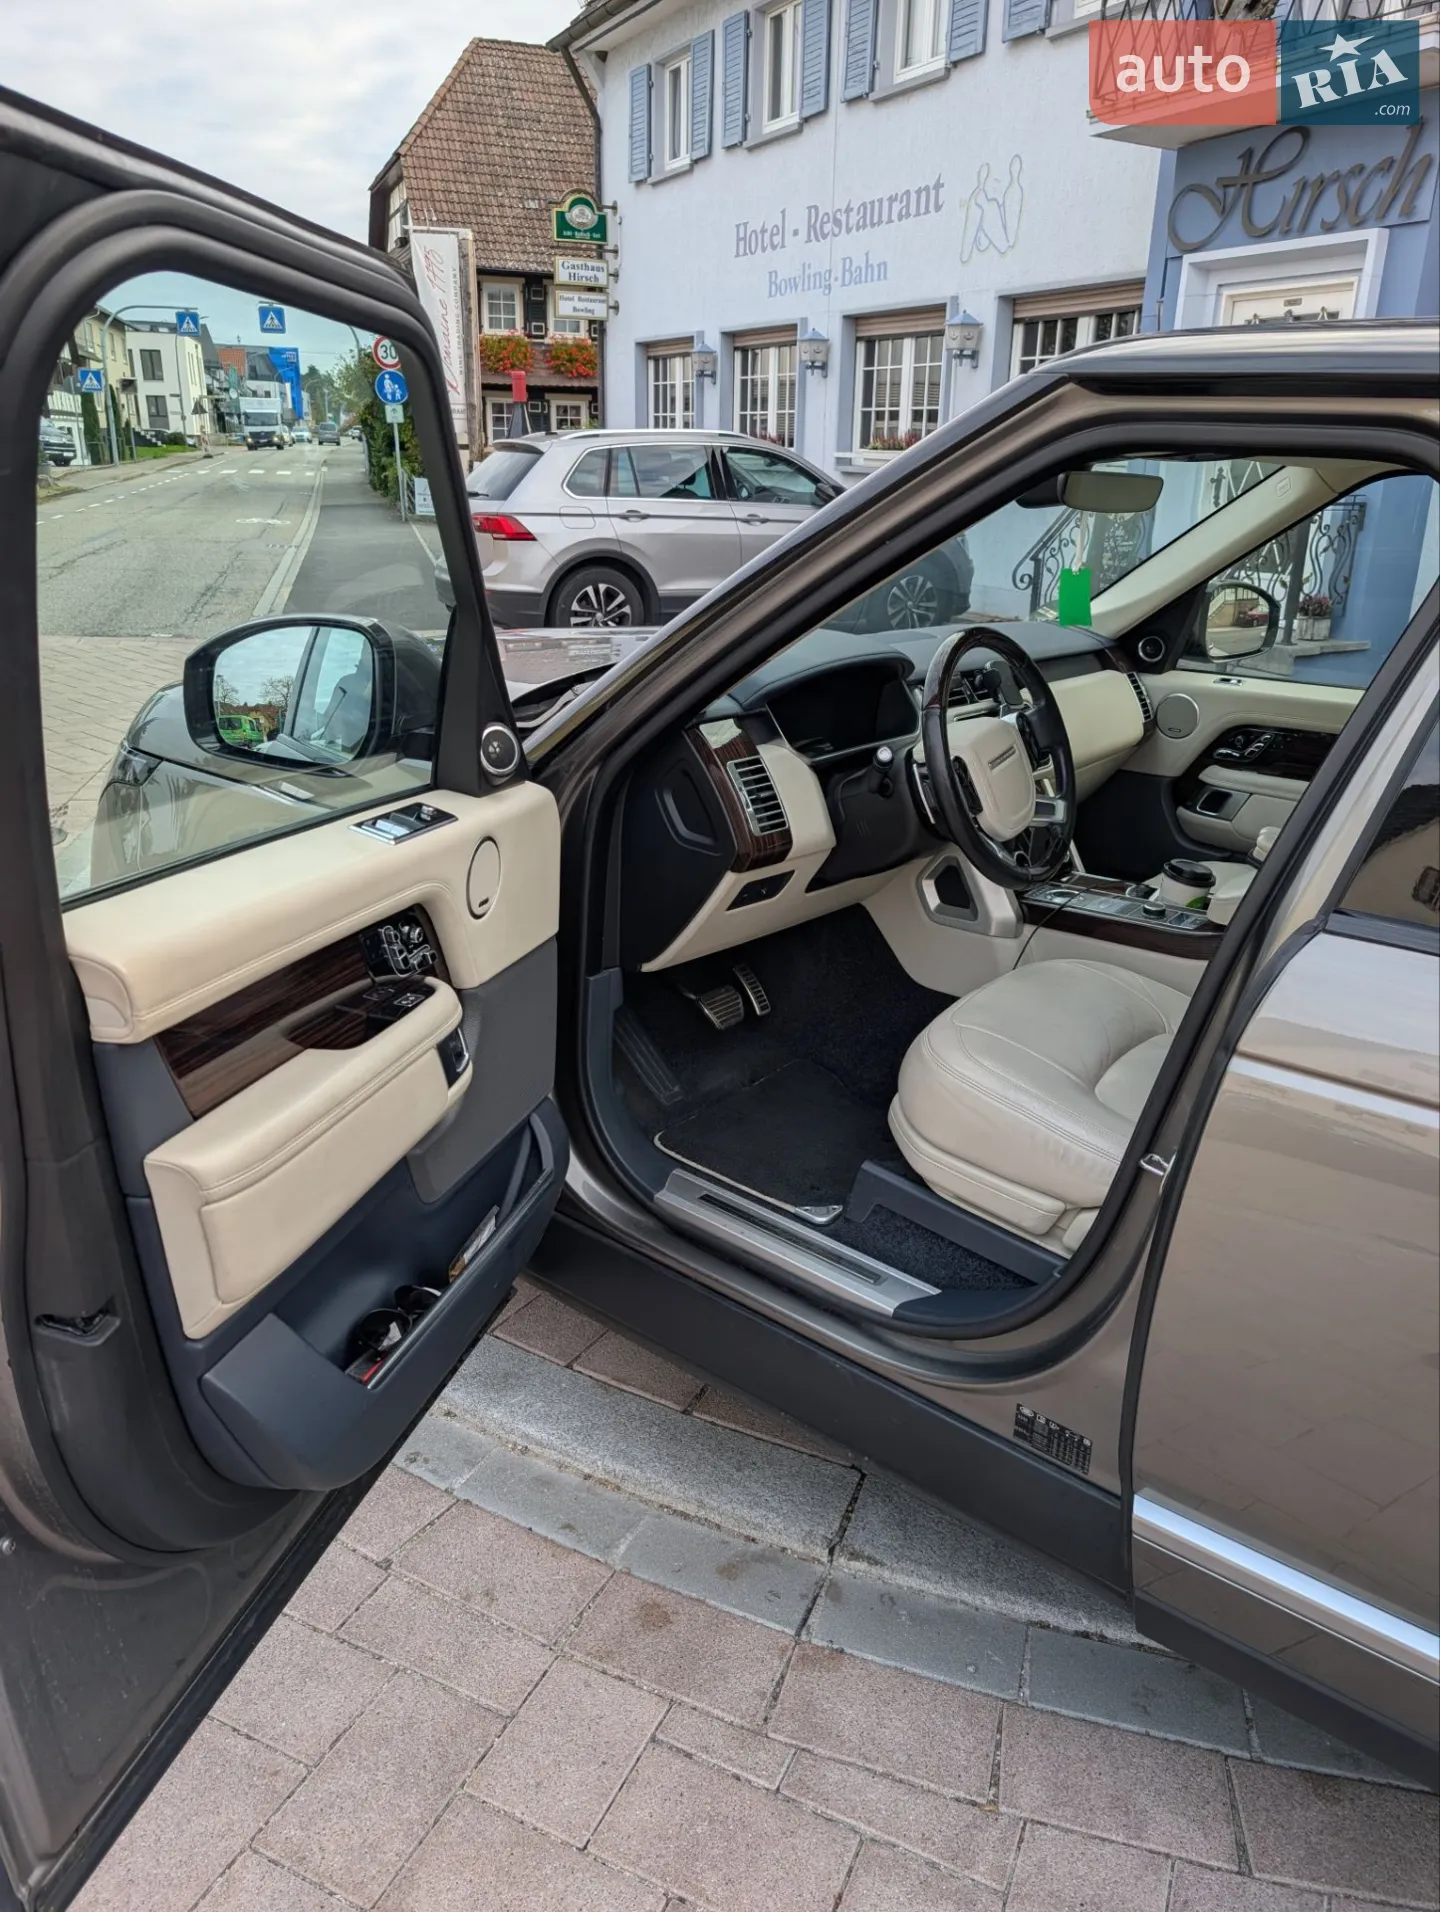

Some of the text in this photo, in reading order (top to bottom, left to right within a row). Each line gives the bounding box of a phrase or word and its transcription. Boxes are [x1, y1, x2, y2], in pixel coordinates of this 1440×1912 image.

[1167, 115, 1433, 253] Hirsch
[734, 208, 786, 258] Hotel
[805, 172, 945, 243] Restaurant
[561, 261, 605, 273] Gasthaus
[568, 272, 599, 283] Hirsch
[380, 344, 397, 360] 30
